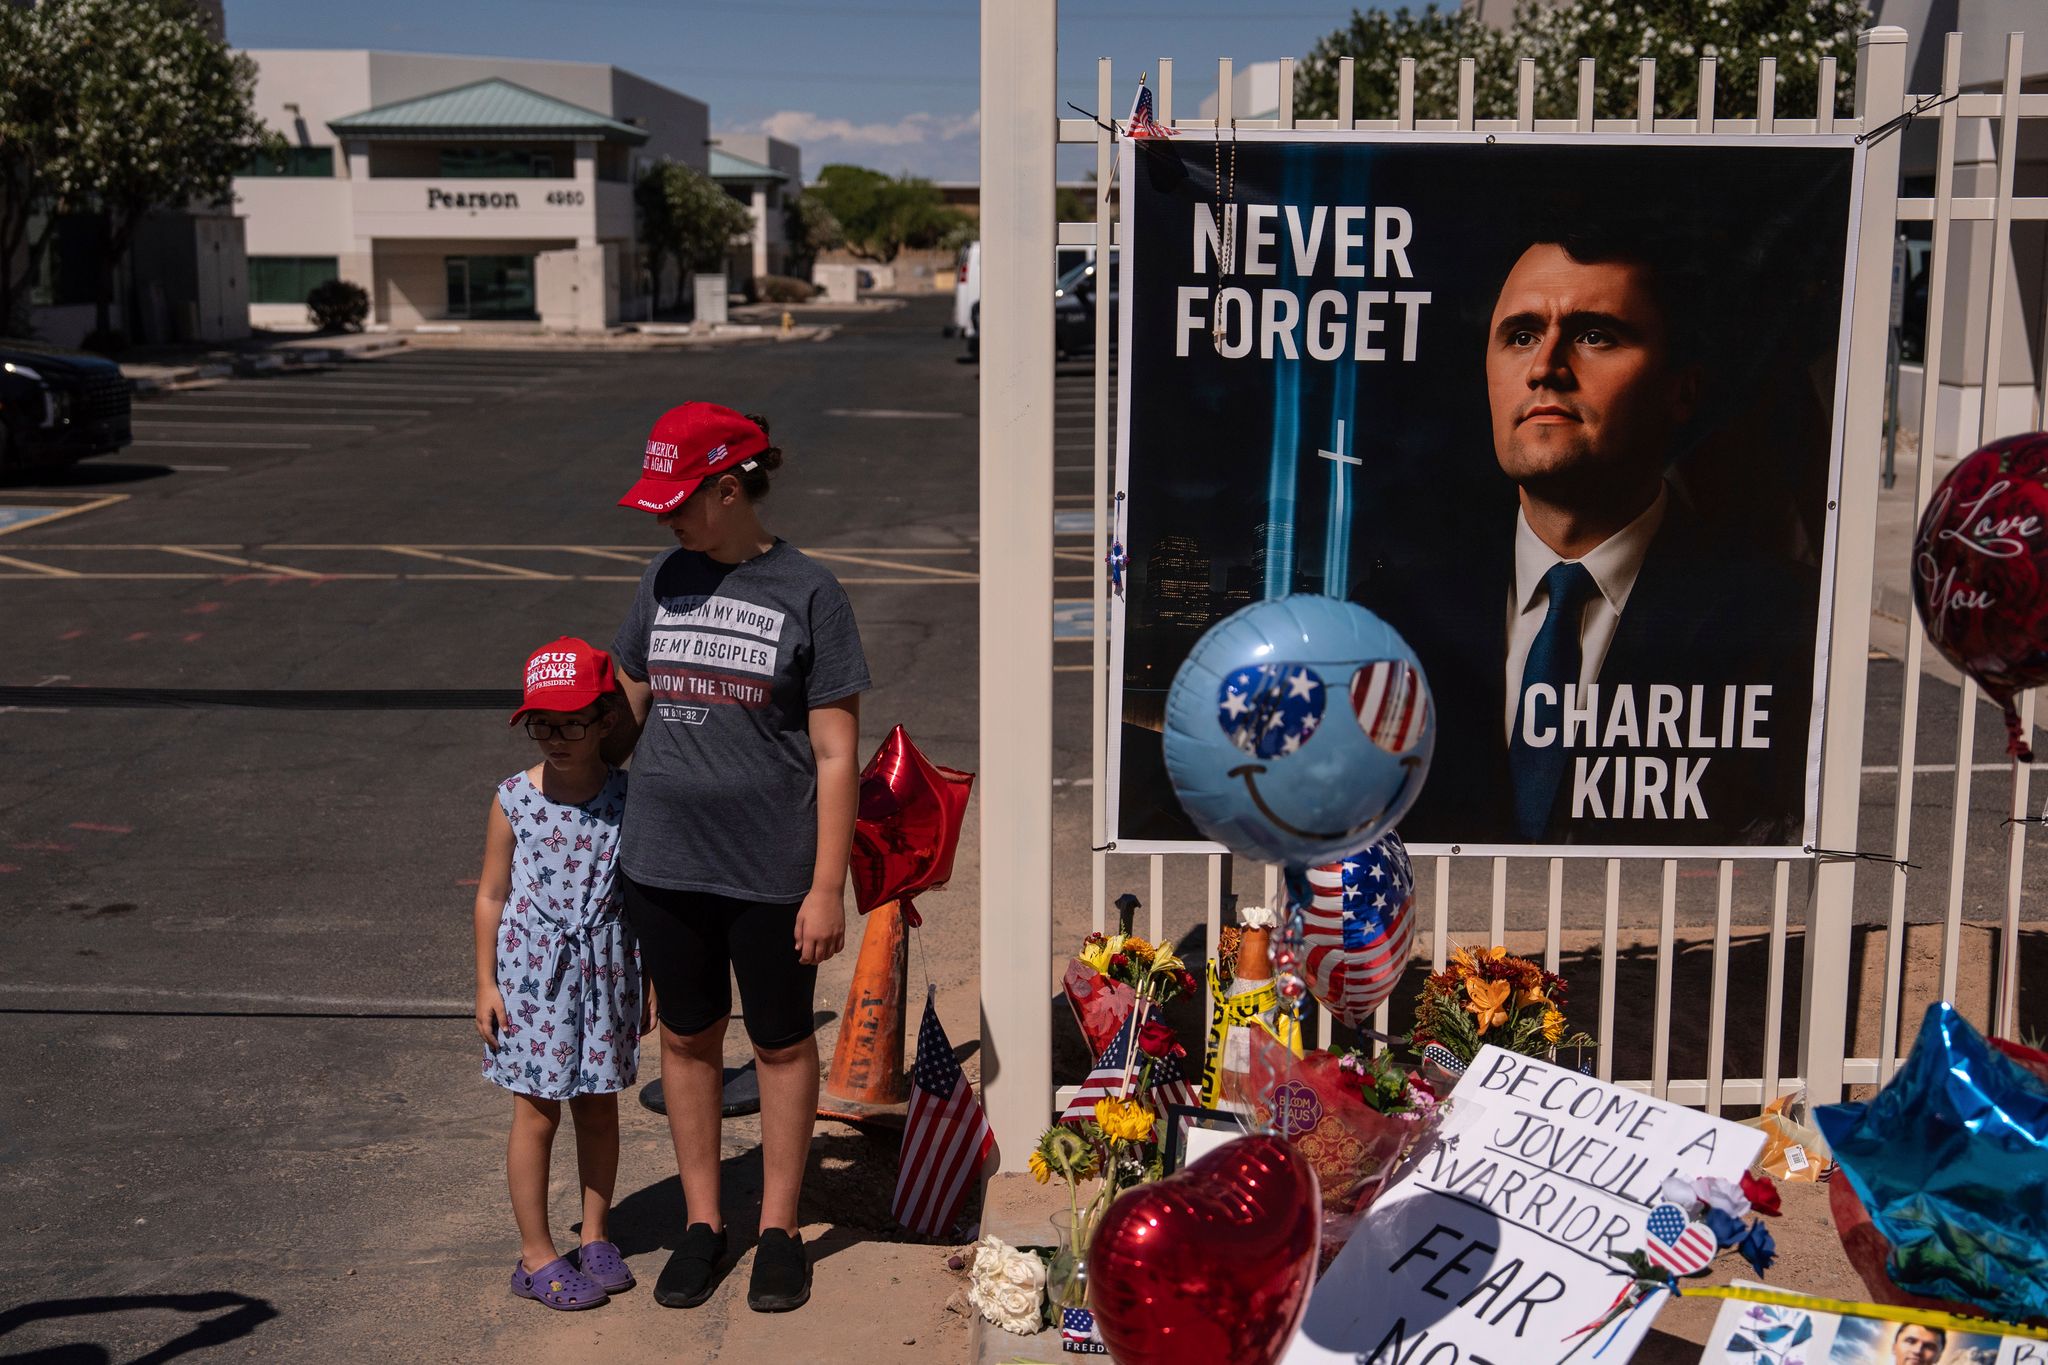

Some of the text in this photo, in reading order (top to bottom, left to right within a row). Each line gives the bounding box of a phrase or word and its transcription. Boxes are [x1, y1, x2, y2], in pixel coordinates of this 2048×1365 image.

[427, 187, 520, 209] Pearson
[1193, 202, 1414, 278] NEVER
[1176, 286, 1432, 362] FORGET
[650, 456, 674, 474] AGAIN
[637, 490, 685, 510] DONALD TRUMP
[1939, 480, 2042, 558] Love
[1917, 552, 1995, 643] You
[663, 603, 775, 632] ABIDE IN MY WORD
[527, 652, 577, 672] JESUS
[652, 638, 768, 666] BE MY DISCIPLES
[526, 668, 577, 689] TRUMP
[541, 662, 576, 672] SAVIOR
[535, 679, 576, 690] PRESIDENT
[650, 674, 763, 703] KNOW THE TRUTH
[1522, 682, 1774, 748] CHARLIE
[1571, 756, 1712, 819] KIRK
[1279, 1095, 1311, 1109] BOOM
[1479, 1054, 1668, 1142] BECOME
[1677, 1127, 1718, 1165] A
[1429, 1142, 1631, 1260] WARRIOR
[1388, 1224, 1567, 1338] FEAR
